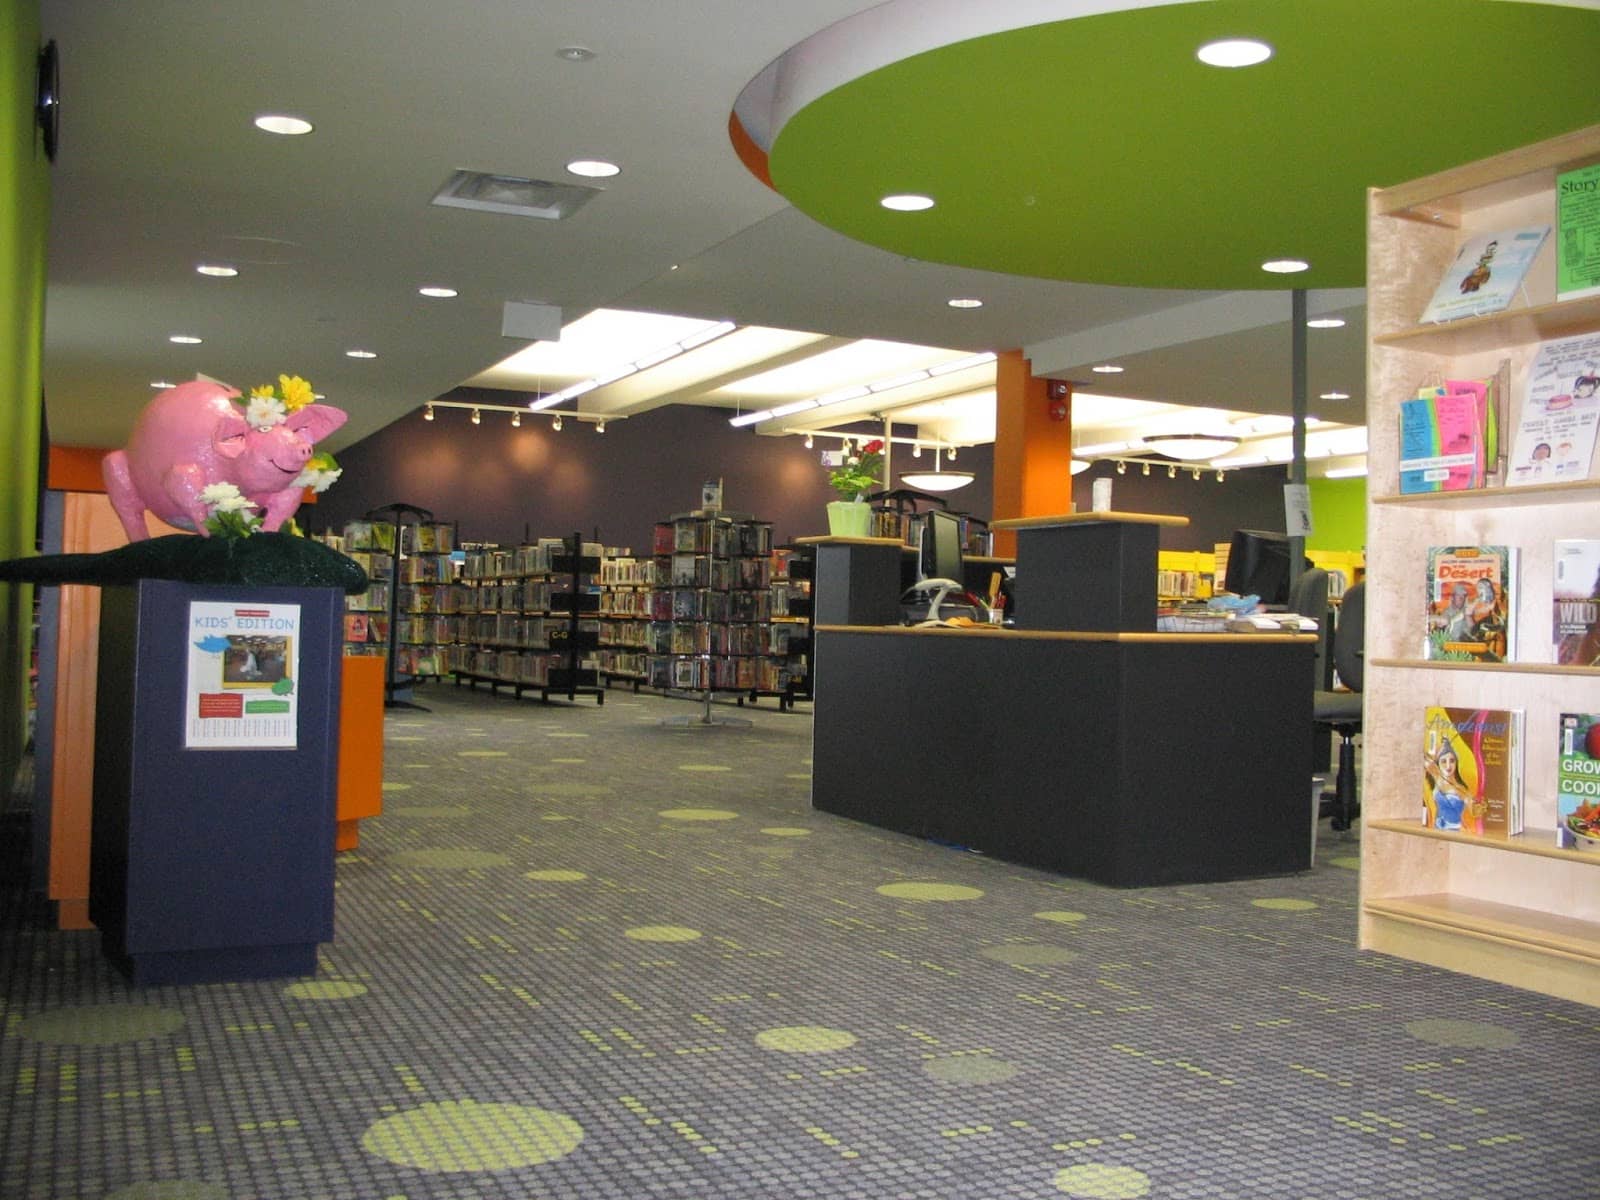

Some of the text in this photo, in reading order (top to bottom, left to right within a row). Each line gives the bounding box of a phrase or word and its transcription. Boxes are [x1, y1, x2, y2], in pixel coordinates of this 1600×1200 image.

[1561, 180, 1599, 195] Story
[1438, 565, 1494, 579] Desert
[1559, 602, 1597, 624] WILD
[236, 617, 295, 630] EDITION
